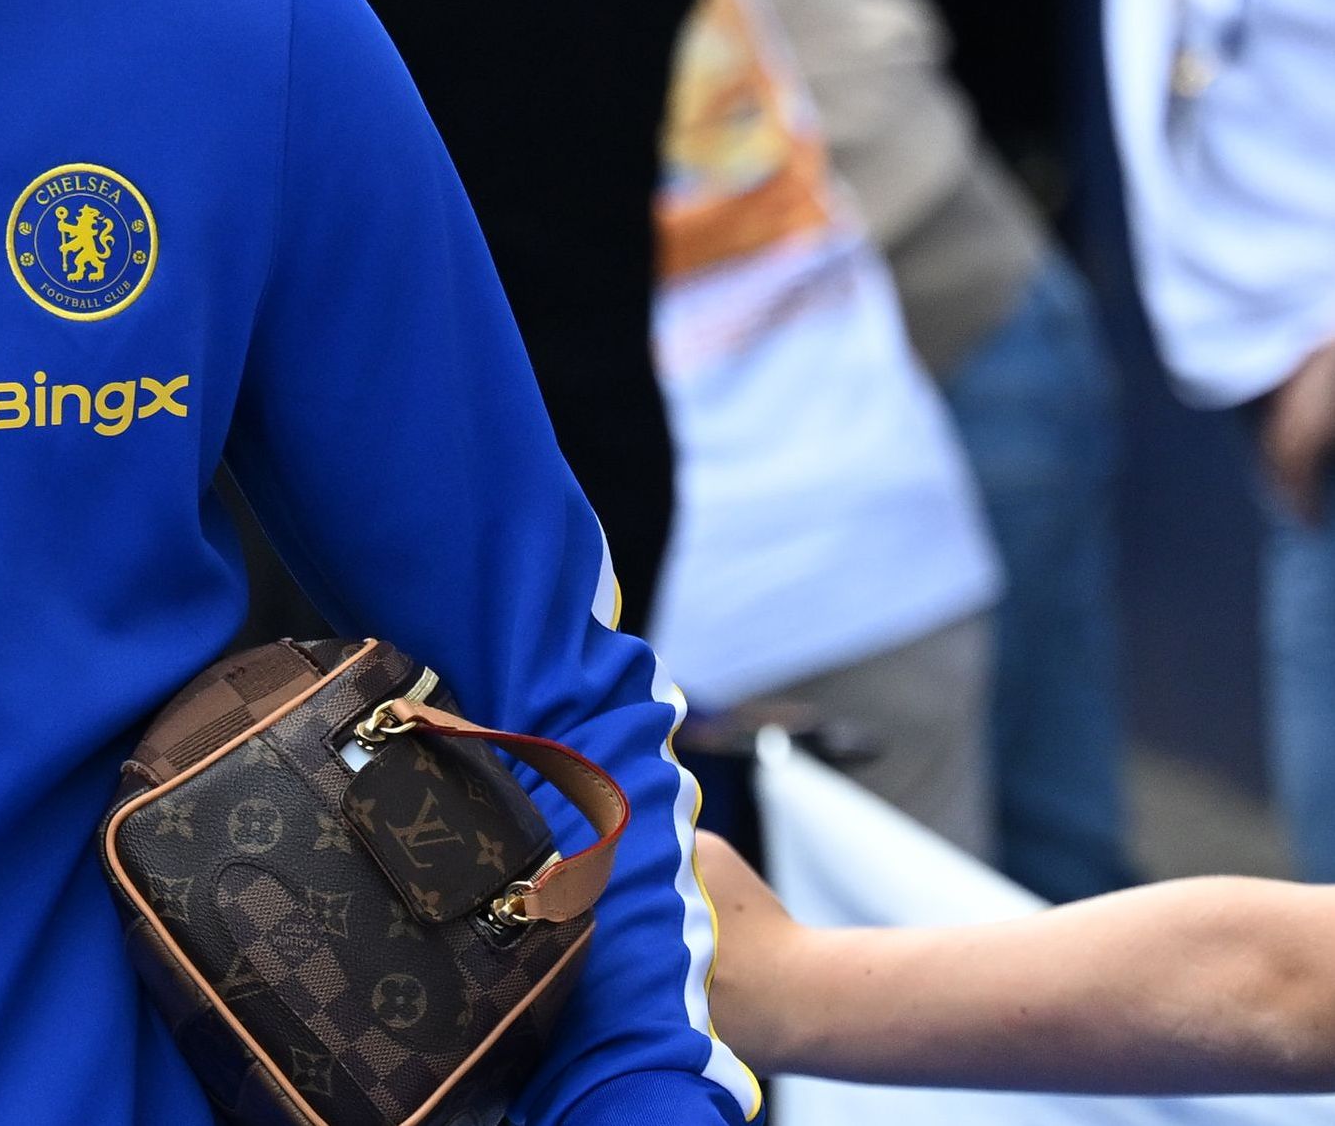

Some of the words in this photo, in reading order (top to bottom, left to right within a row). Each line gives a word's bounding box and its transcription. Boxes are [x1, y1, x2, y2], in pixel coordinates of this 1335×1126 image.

[35, 176, 122, 205] CHELSEA
[39, 282, 102, 309] FOOTBALL
[104, 280, 132, 304] CLUB
